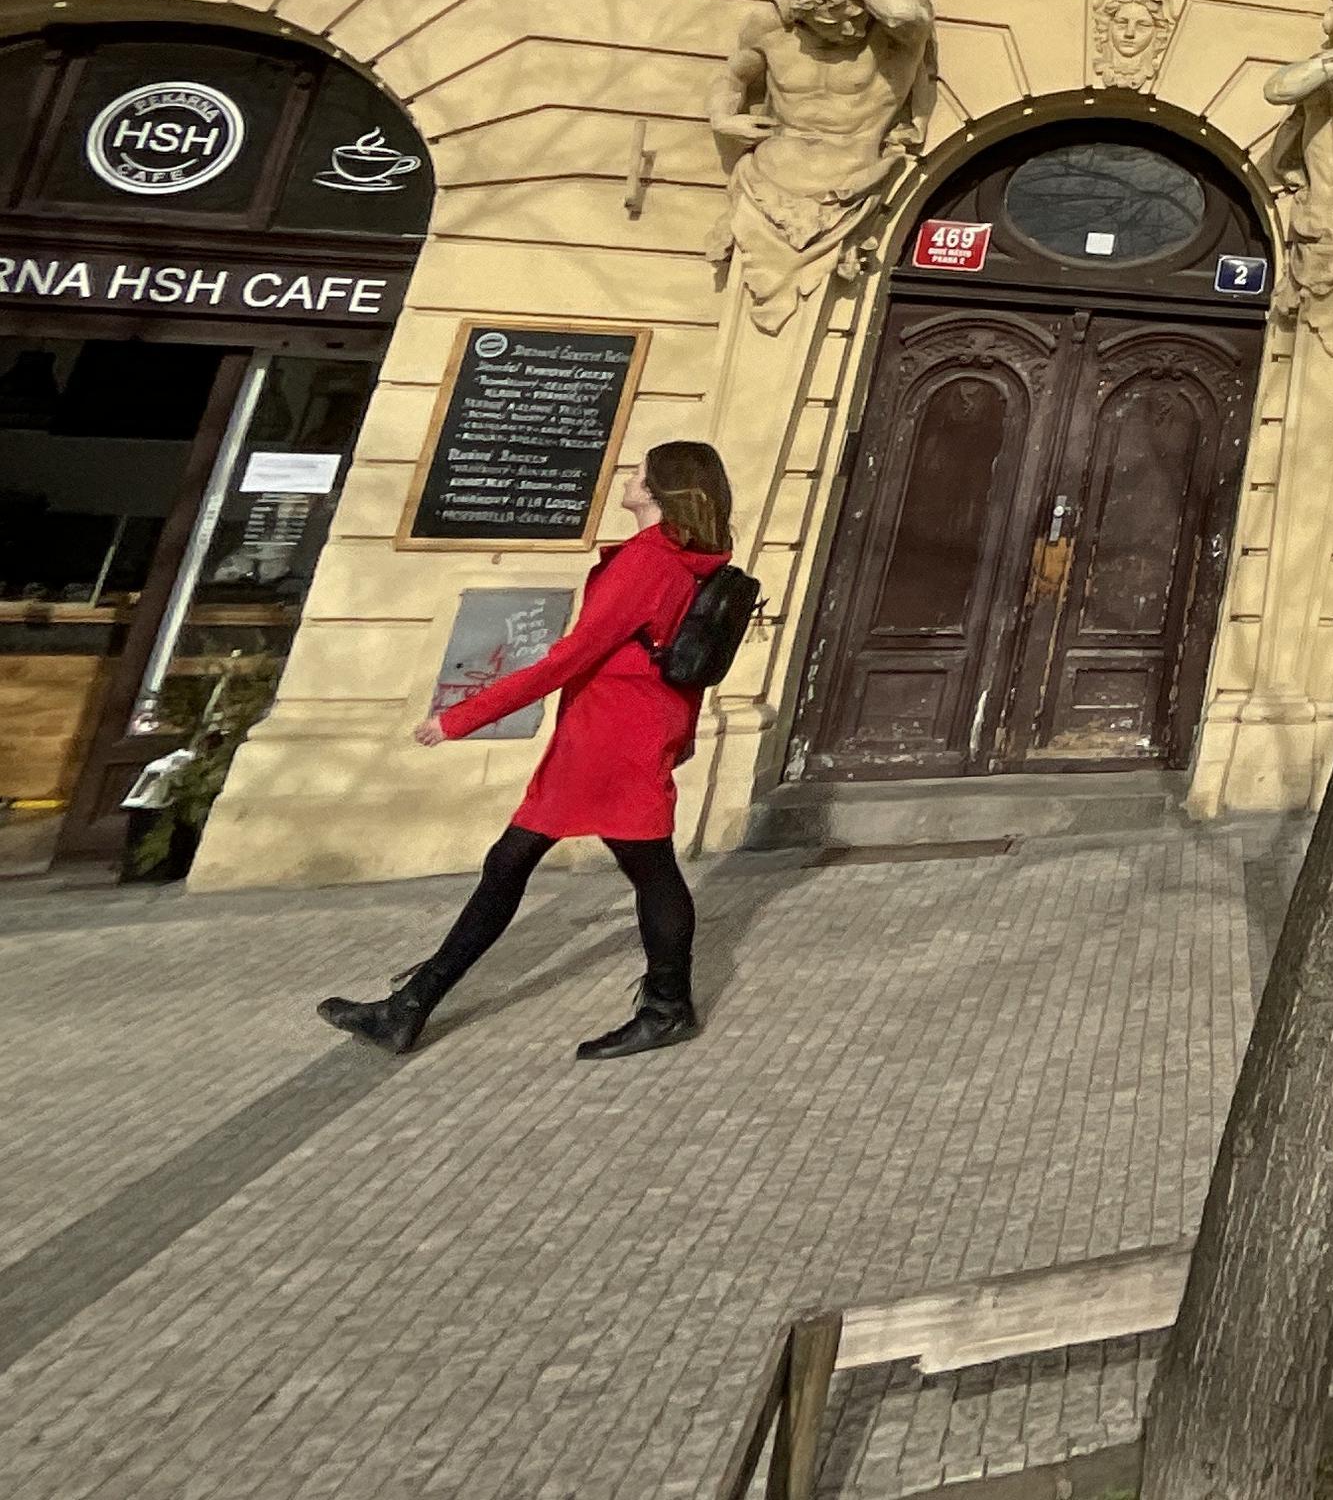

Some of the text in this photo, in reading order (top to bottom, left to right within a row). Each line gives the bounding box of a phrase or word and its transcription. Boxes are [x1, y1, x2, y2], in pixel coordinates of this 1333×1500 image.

[112, 119, 220, 155] HSH
[930, 227, 976, 249] 469
[107, 264, 228, 305] HSH
[243, 272, 387, 314] CAFE
[1234, 265, 1249, 286] 2
